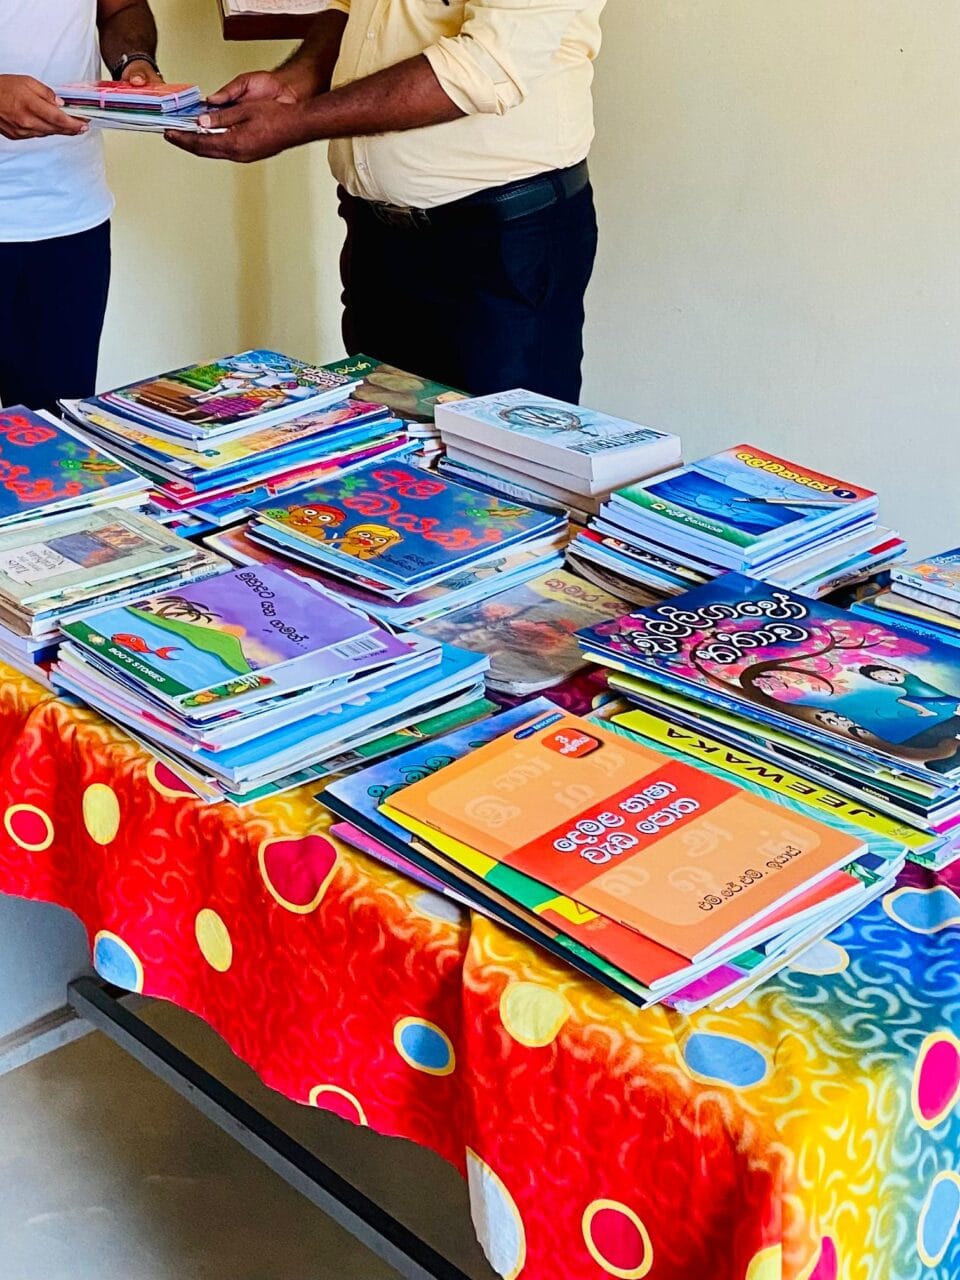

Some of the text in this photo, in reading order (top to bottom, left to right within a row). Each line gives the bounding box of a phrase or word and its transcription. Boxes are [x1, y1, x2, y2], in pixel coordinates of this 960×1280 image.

[108, 646, 166, 683] BOO'S STORIES
[666, 728, 876, 818] JEEWAKA
[636, 798, 700, 834] පොත
